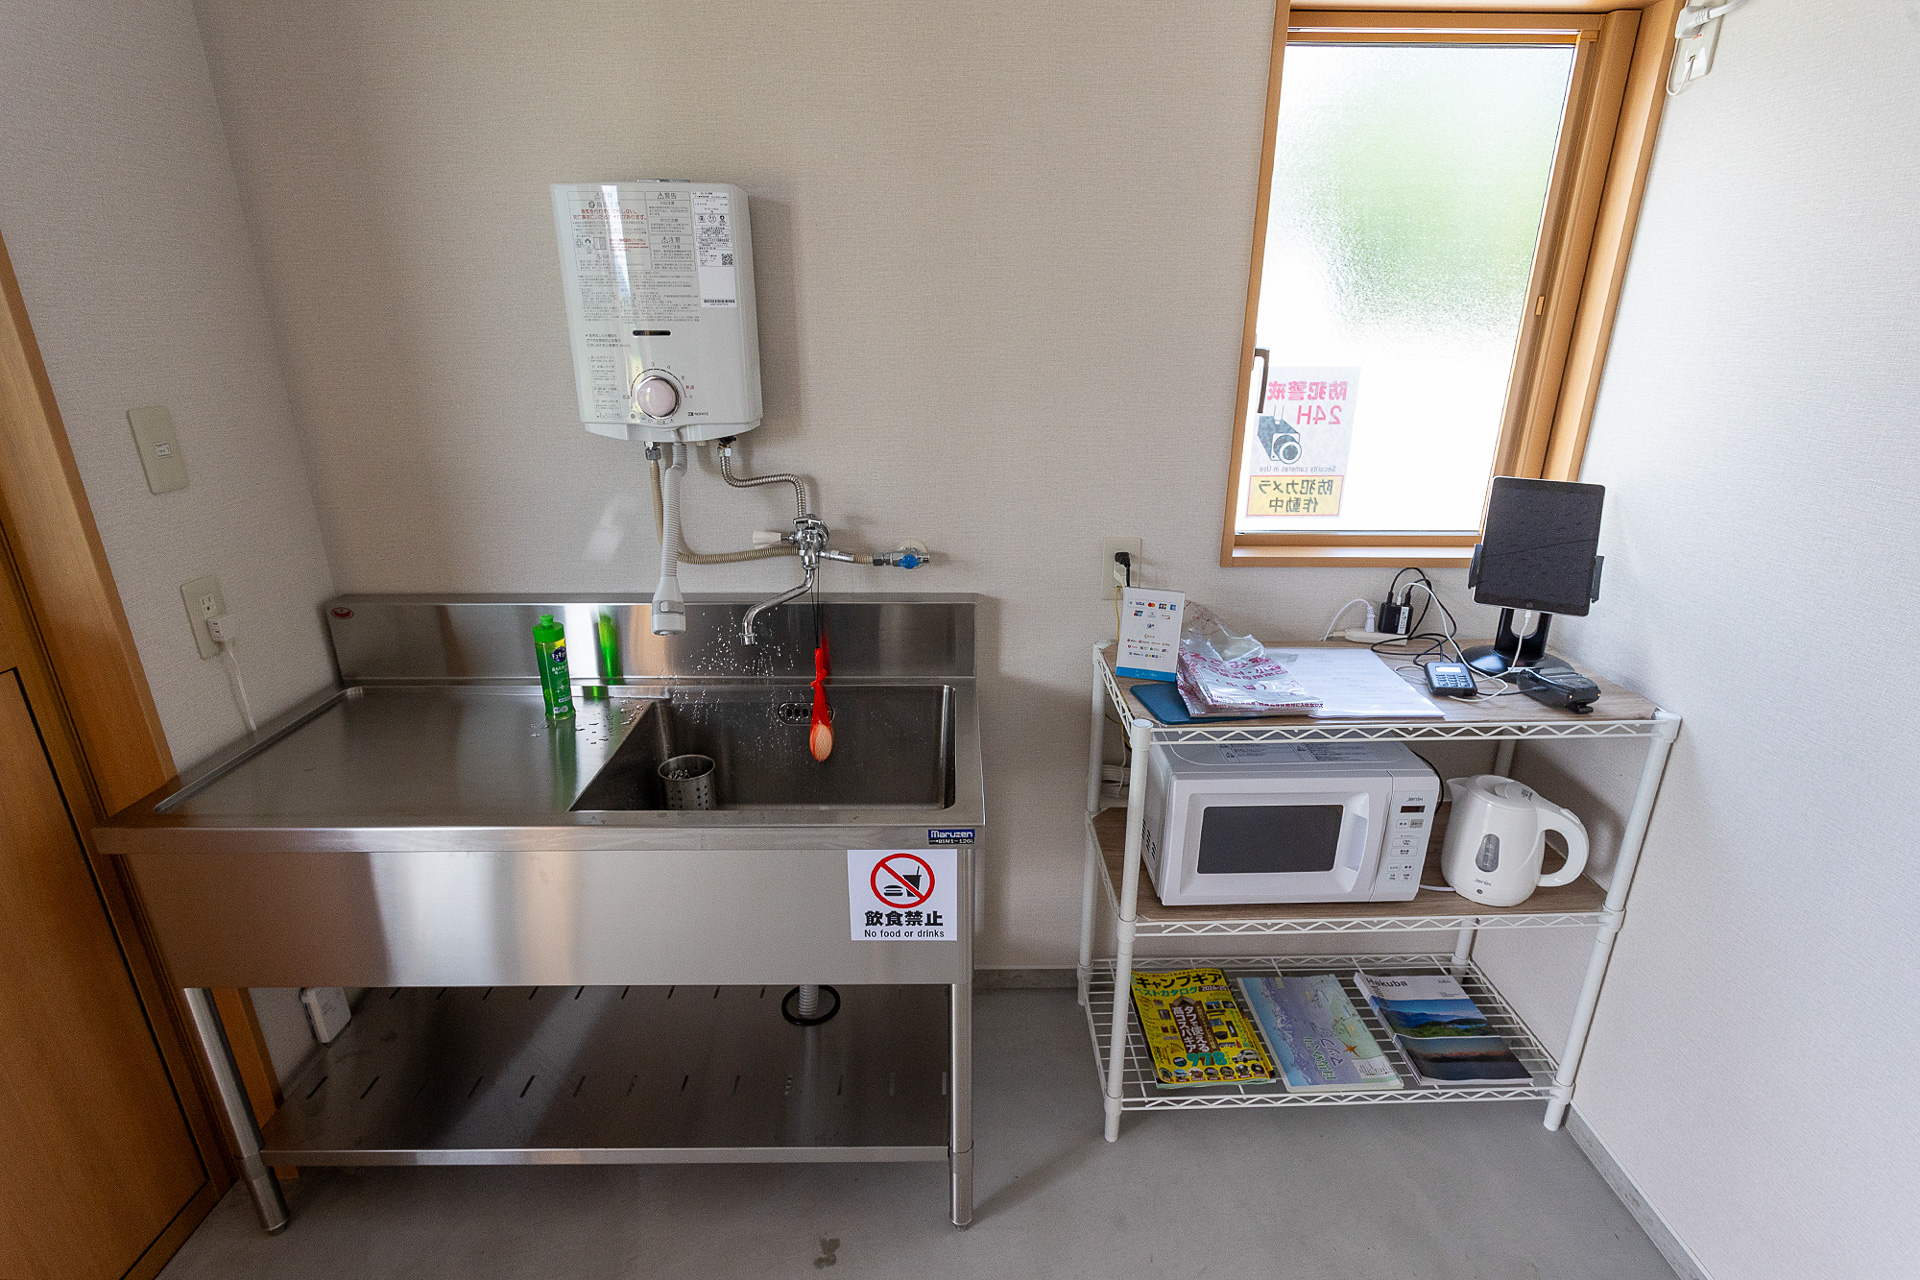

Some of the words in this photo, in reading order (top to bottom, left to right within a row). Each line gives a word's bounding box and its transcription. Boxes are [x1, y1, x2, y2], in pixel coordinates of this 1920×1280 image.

[864, 910, 944, 926] 飲食禁止
[864, 930, 876, 938] No
[880, 930, 900, 938] food
[918, 930, 944, 938] drinks
[1136, 972, 1222, 989] キャンプギア
[1365, 977, 1408, 988] Hakuba
[1134, 986, 1198, 998] ベストカタログ
[1184, 1006, 1210, 1052] タフで使える
[1186, 1051, 1228, 1067] 978
